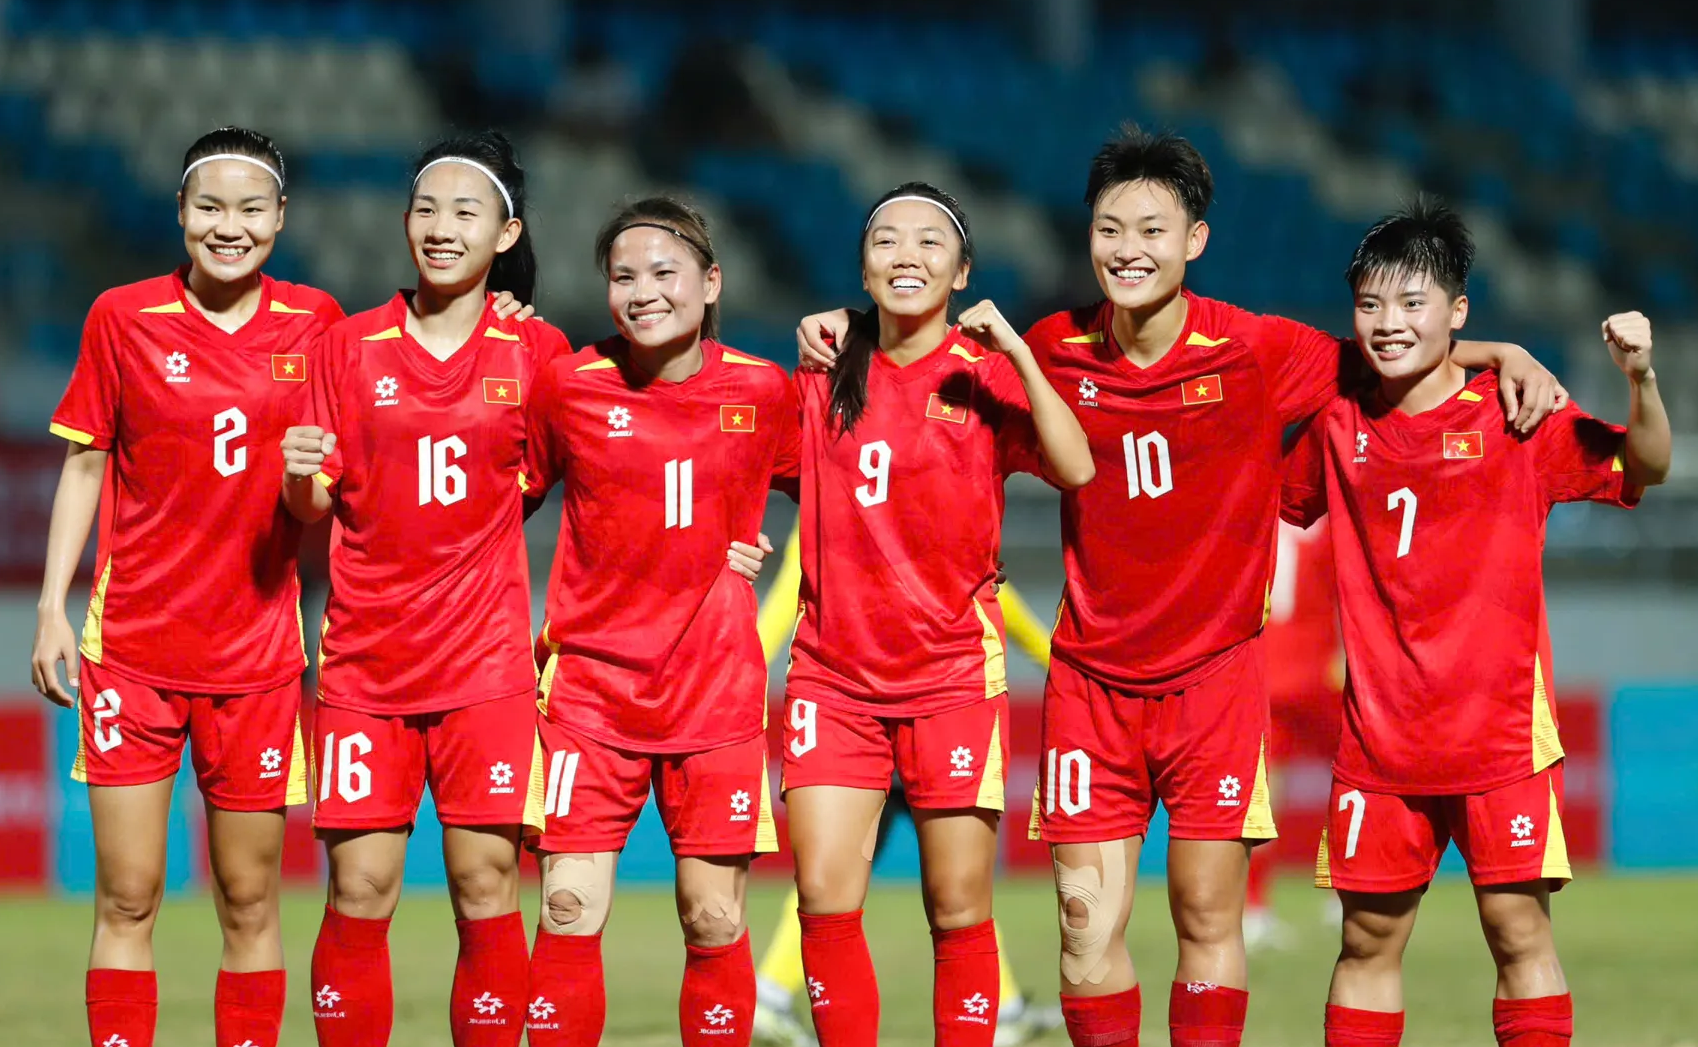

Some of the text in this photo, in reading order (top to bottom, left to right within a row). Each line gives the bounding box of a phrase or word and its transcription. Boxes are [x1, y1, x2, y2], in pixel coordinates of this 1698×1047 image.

[213, 407, 247, 477] 2
[418, 435, 467, 506] 16
[855, 440, 892, 508] 9
[1123, 431, 1173, 499] 10
[664, 458, 692, 529] 11
[1388, 487, 1417, 558] 7
[93, 689, 122, 753] 2
[790, 698, 817, 757] 9
[319, 731, 372, 803] 16
[545, 749, 580, 818] 11
[1046, 748, 1091, 816] 10
[1339, 790, 1365, 858] 7
